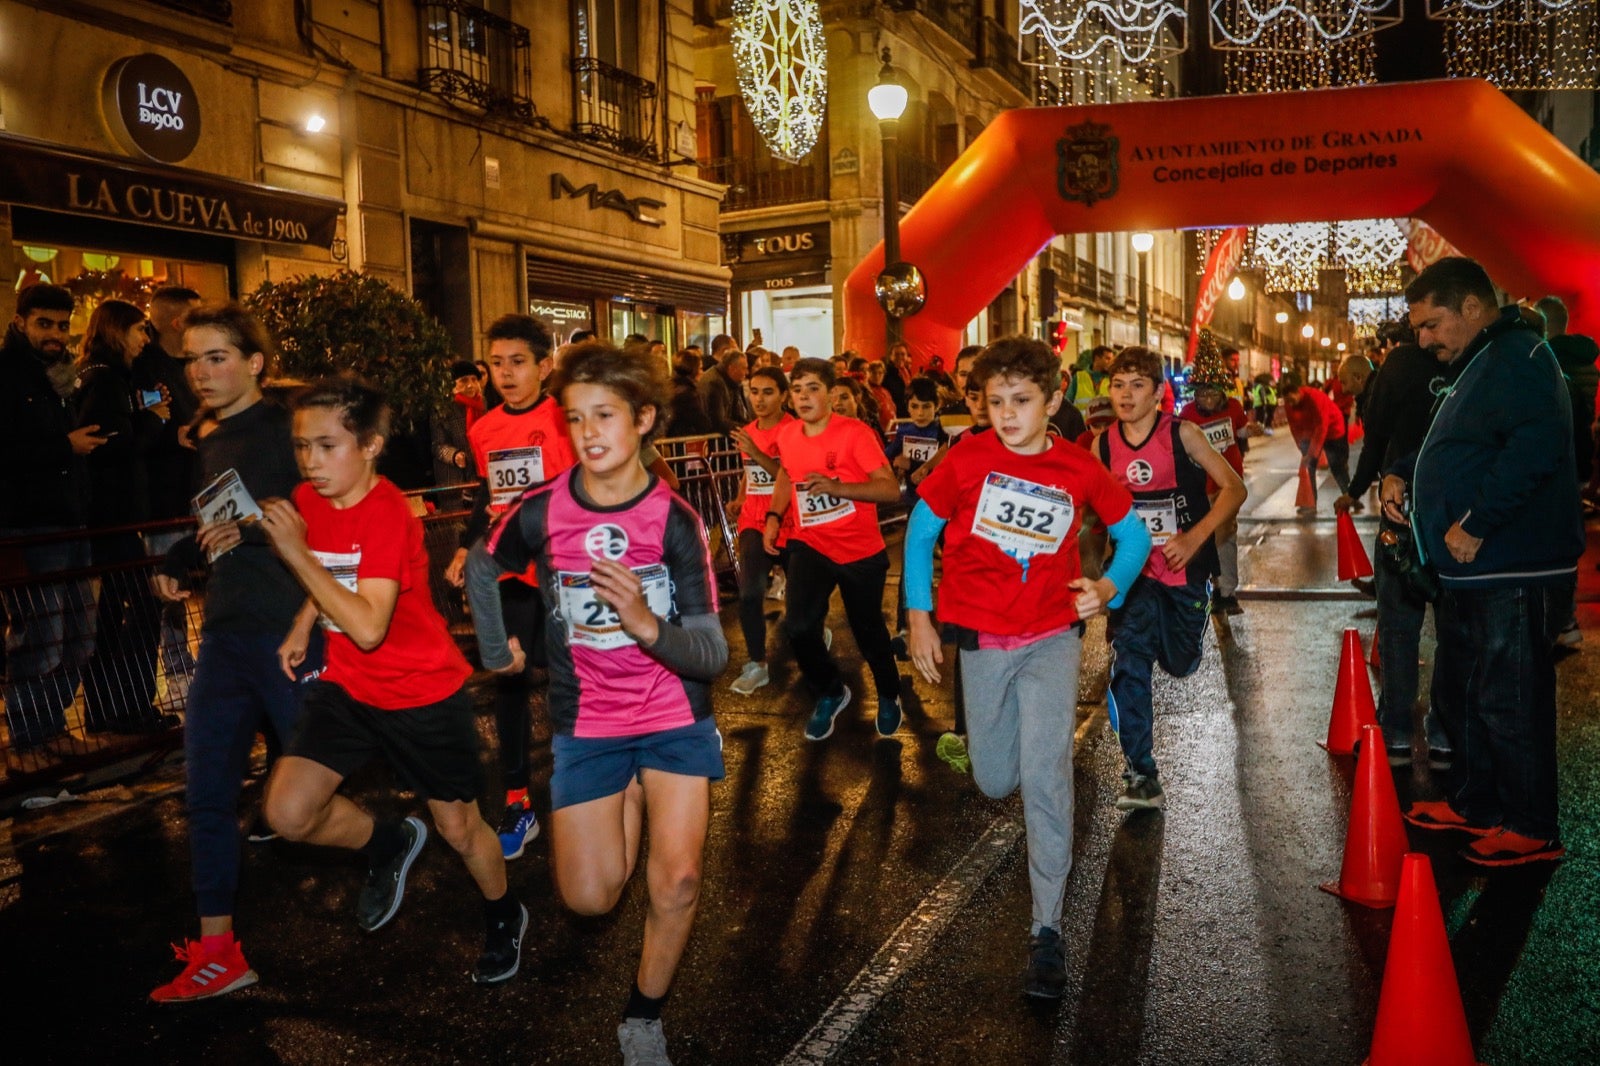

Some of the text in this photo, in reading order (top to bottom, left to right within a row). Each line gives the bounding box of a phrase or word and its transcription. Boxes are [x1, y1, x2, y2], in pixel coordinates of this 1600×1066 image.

[138, 82, 182, 114] LCV
[1153, 152, 1398, 183] Concejalía de Deportes
[67, 173, 308, 241] LA CUEVA de 1900
[753, 232, 814, 254] TOUS
[765, 277, 794, 289] TOUS
[908, 448, 929, 460] 161
[496, 467, 531, 487] 303
[996, 501, 1054, 534] 352
